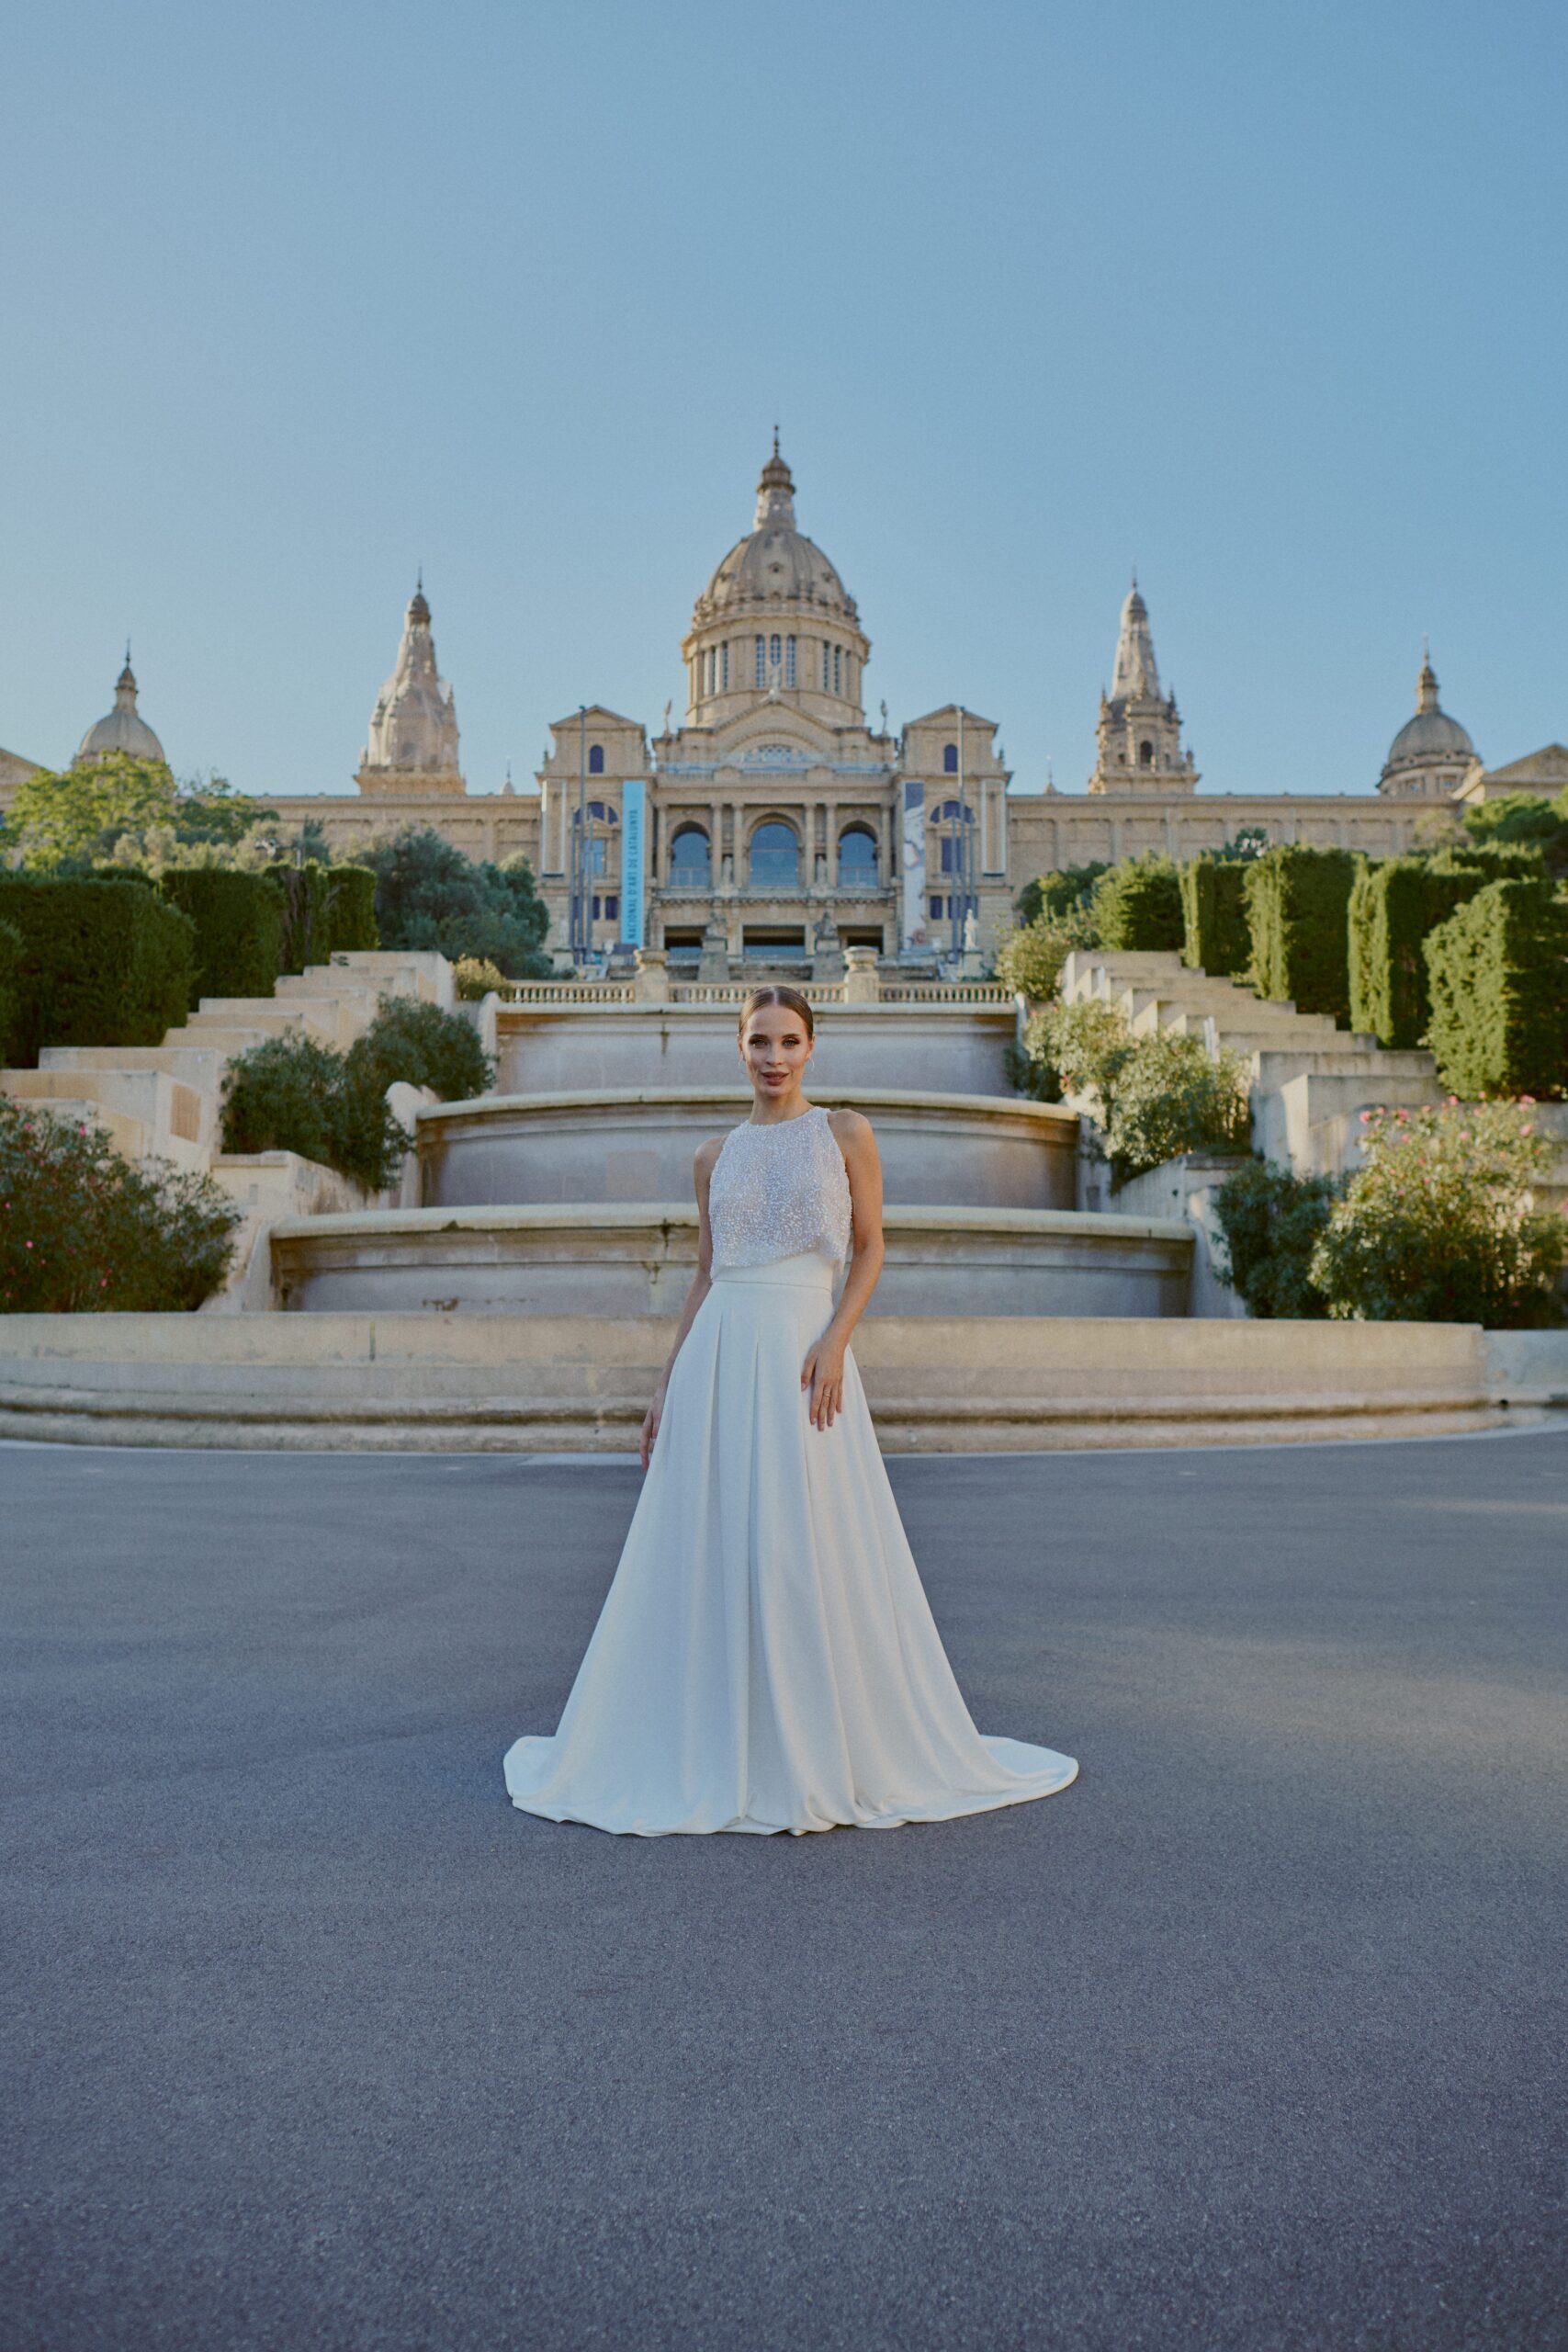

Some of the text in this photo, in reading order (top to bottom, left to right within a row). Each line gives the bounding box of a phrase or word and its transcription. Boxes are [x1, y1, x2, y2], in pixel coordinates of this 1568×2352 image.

[627, 809, 638, 939] NACIONAL D'ART DE CATALUNYA
